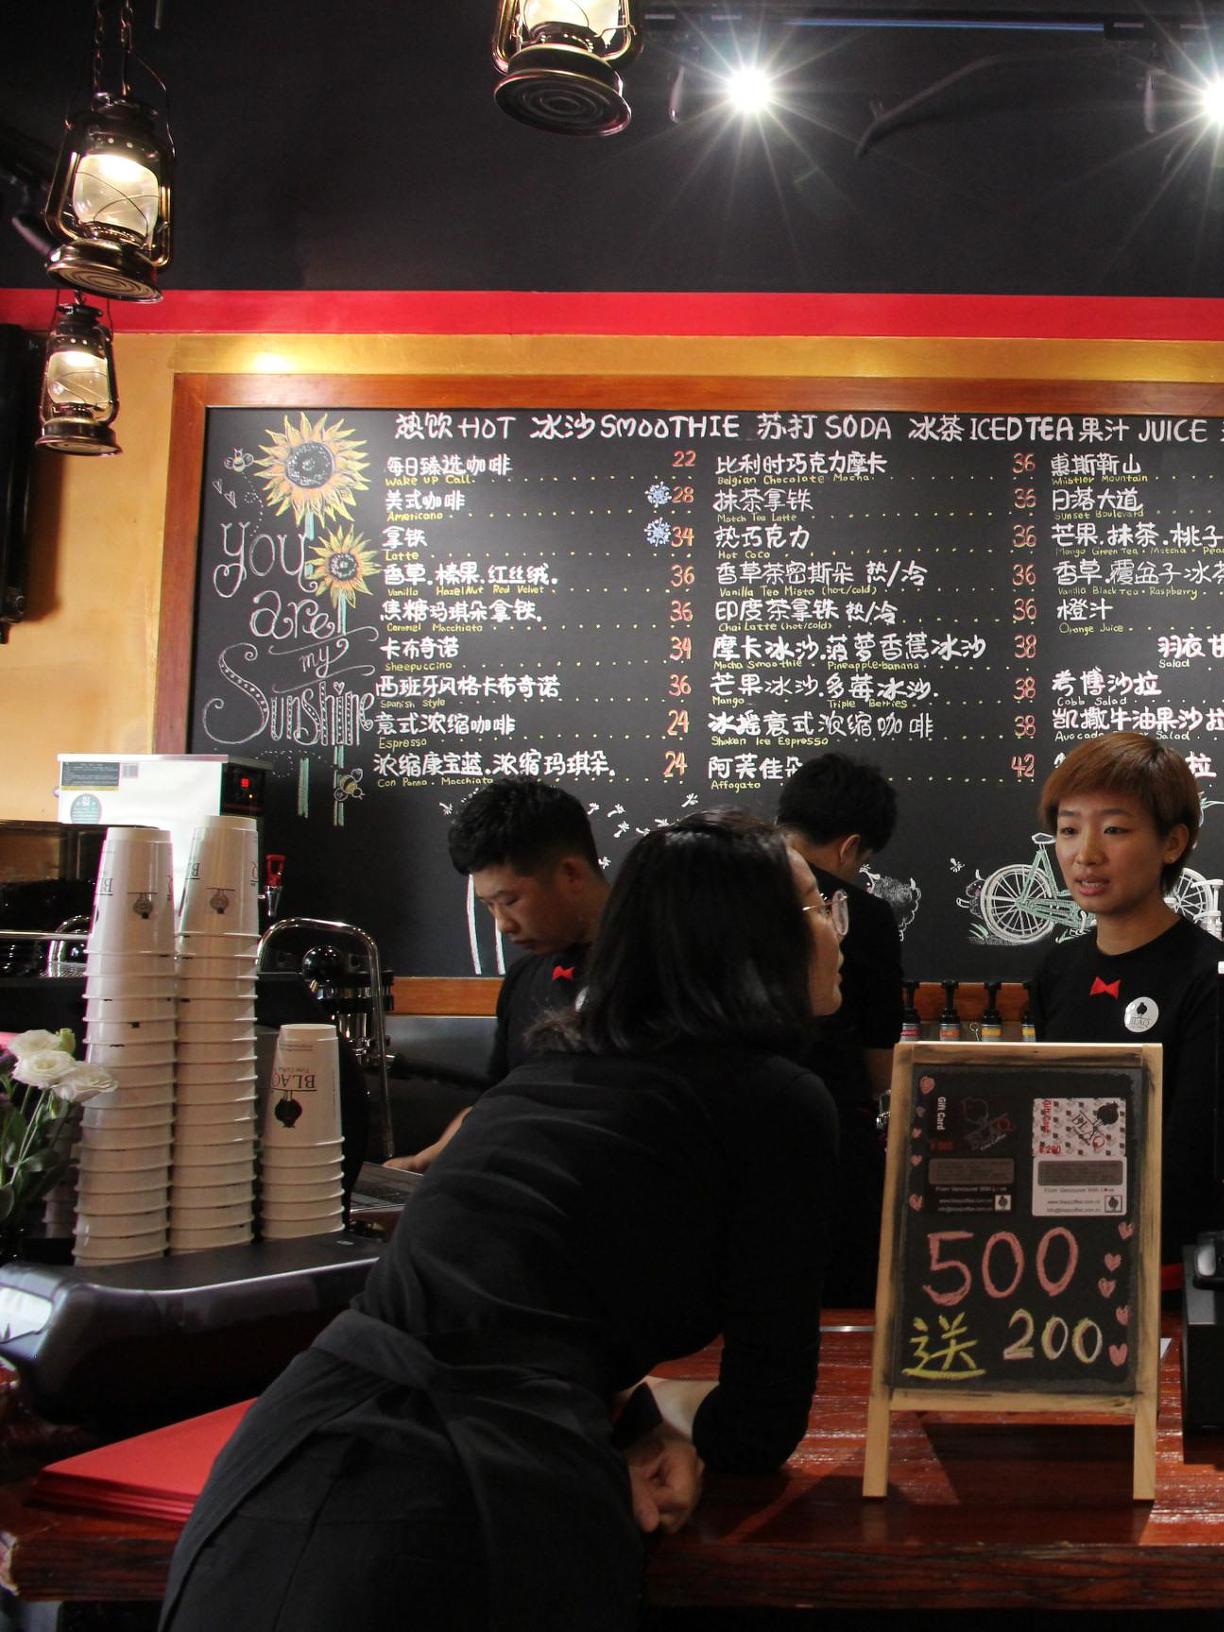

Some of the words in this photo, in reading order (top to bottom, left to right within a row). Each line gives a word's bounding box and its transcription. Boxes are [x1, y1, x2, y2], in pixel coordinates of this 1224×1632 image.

[395, 414, 453, 439] 热饮
[458, 416, 516, 439] HOT
[529, 412, 595, 439] 冰沙
[600, 415, 739, 439] SMOOTHIE
[757, 412, 817, 440] 苏打
[825, 415, 892, 440] SODA
[909, 415, 964, 442] 冰茶
[1078, 418, 1130, 442] 果汁
[1138, 420, 1208, 443] JUICE
[672, 450, 697, 468] 22
[715, 450, 888, 476] 比利时巧克力摩卡
[1013, 453, 1036, 474] 36
[384, 489, 466, 511] 美式咖啡
[672, 486, 694, 504] 28
[712, 487, 814, 513] 抹茶拿铁
[1013, 488, 1037, 509] 36
[1052, 486, 1144, 512] 日落大道
[382, 525, 428, 549] 拿铁
[671, 526, 695, 549] 34
[713, 523, 811, 550] 热巧克力
[1012, 525, 1037, 549] 36
[671, 564, 696, 587] 36
[715, 560, 855, 586] 香草茶密斯朵
[1013, 564, 1037, 586] 36
[249, 589, 336, 640] are
[669, 600, 693, 622] 36
[715, 597, 840, 623] 印度茶拿铁
[1013, 598, 1037, 621] 36
[1055, 597, 1114, 621] 橙汁
[380, 635, 460, 661] 卡布奇诺
[669, 636, 693, 661] 34
[1014, 634, 1038, 660] 38
[375, 673, 561, 699] 西班牙风格卡布奇诺
[669, 674, 692, 696] 36
[1013, 676, 1037, 701] 38
[374, 711, 517, 736] 意式浓缩咖啡
[667, 709, 690, 736] 24
[1014, 714, 1037, 738] 38
[664, 751, 688, 778] 24
[1010, 753, 1036, 778] 42
[936, 1112, 946, 1131] Card
[922, 1226, 1079, 1306] 500
[901, 1311, 987, 1381] 送
[1002, 1308, 1103, 1365] 200
